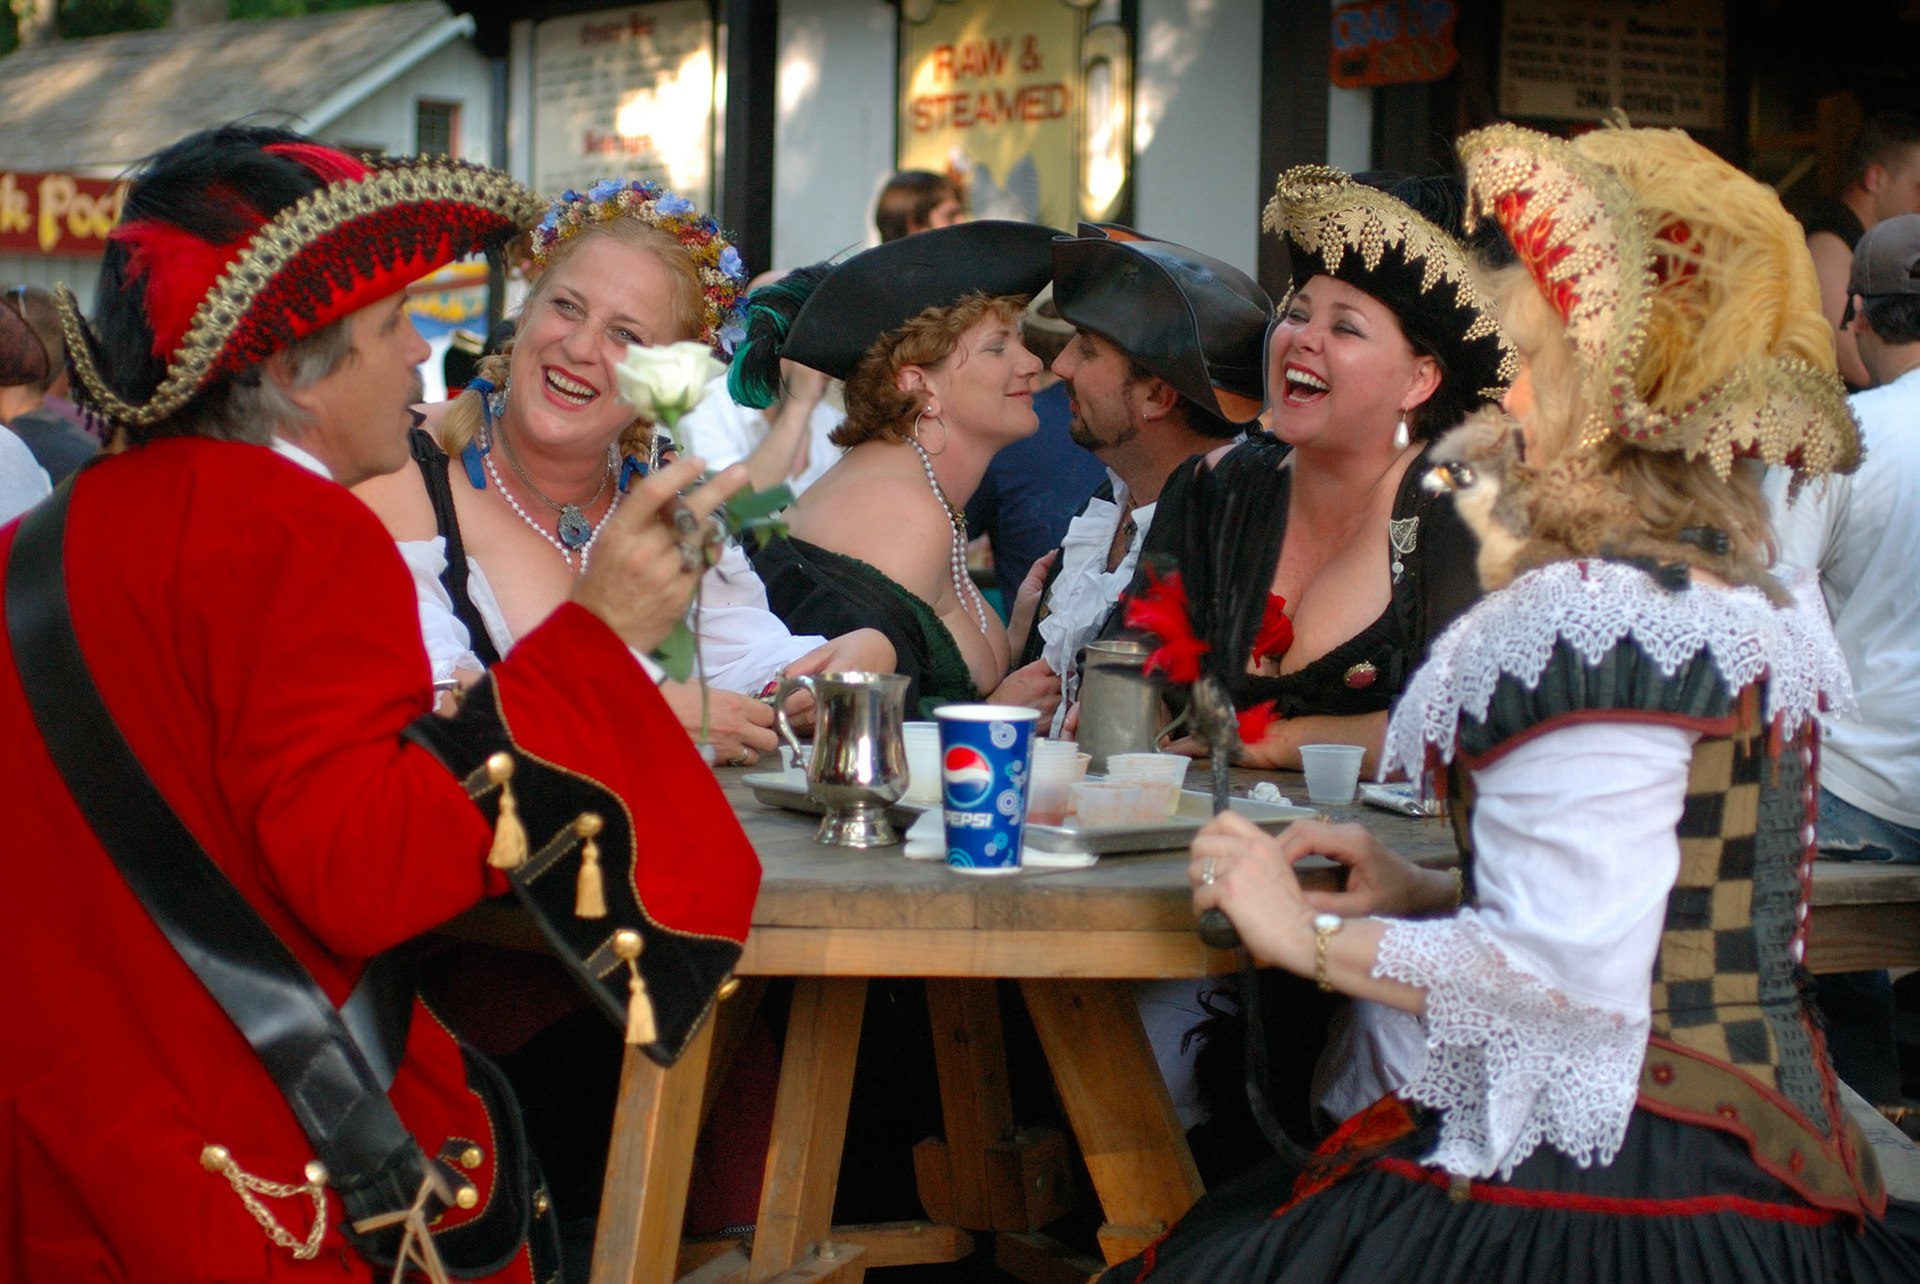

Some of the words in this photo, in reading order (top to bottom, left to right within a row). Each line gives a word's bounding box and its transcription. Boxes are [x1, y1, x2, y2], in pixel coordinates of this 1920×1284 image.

[931, 37, 1012, 83] RAW
[1018, 34, 1043, 72] &
[910, 81, 1073, 133] STEAMED
[945, 810, 994, 828] PEPSI
